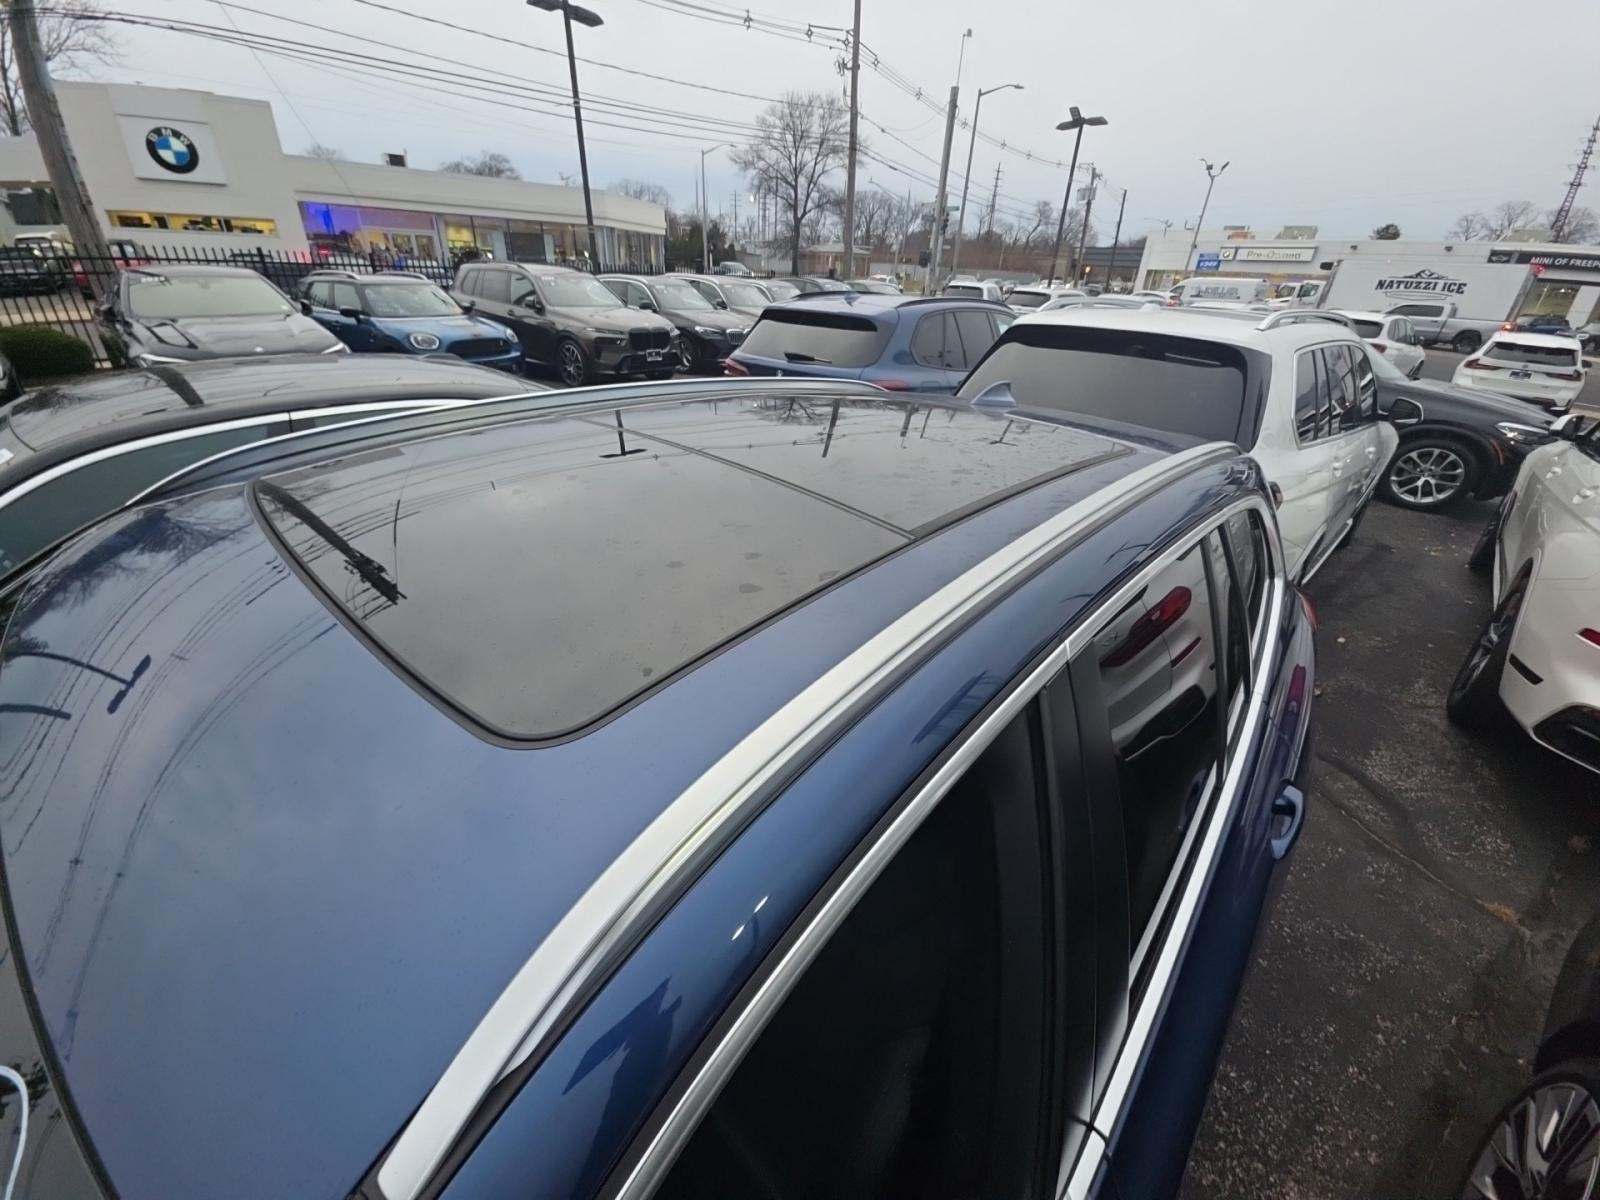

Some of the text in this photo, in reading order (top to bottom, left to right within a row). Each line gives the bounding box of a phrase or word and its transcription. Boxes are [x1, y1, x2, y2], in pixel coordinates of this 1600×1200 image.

[148, 128, 190, 146] BMW
[1530, 256, 1553, 265] MINI
[1554, 257, 1569, 265] OF
[1375, 279, 1467, 295] NATUZZI ICE
